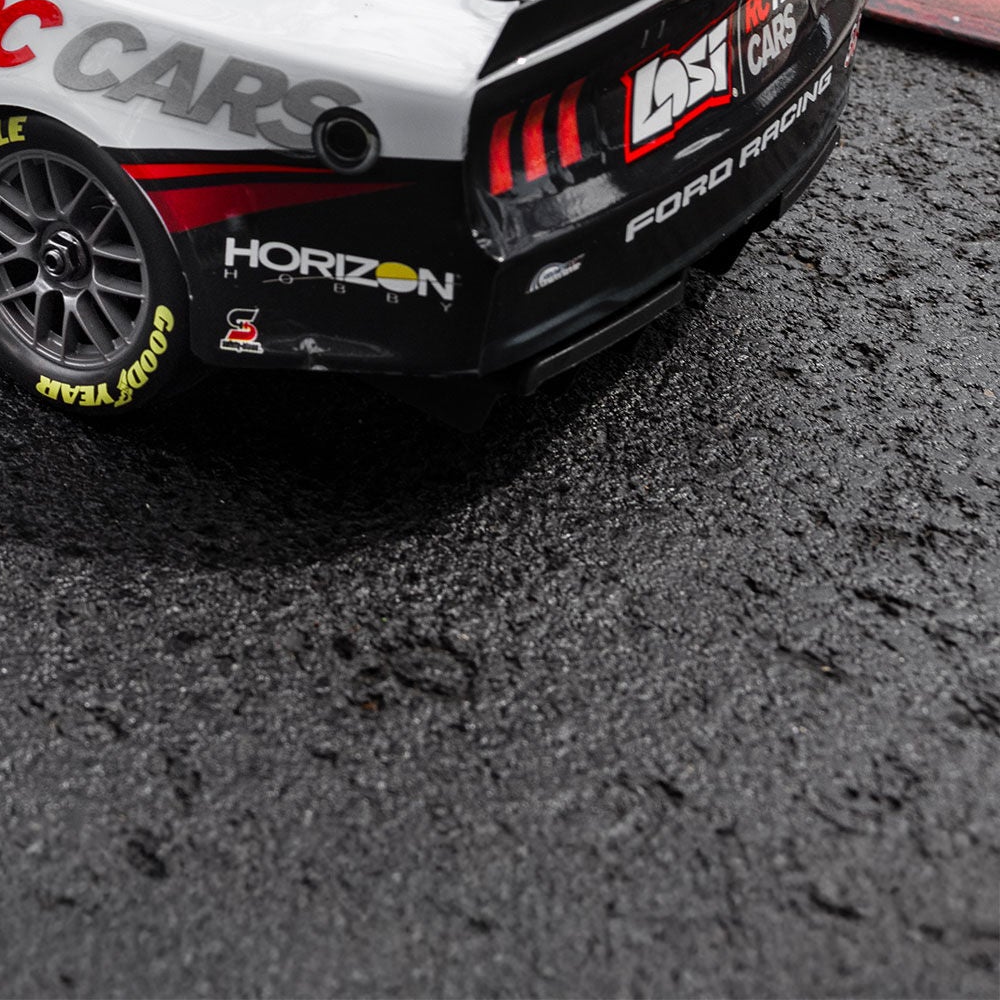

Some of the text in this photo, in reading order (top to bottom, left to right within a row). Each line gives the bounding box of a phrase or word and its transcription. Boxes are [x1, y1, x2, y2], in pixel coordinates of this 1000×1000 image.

[53, 21, 363, 152] CARS
[747, 2, 798, 75] CARS
[625, 65, 834, 243] FORD RACING
[224, 237, 455, 301] HORIZON
[35, 304, 175, 408] GOODYEAR
